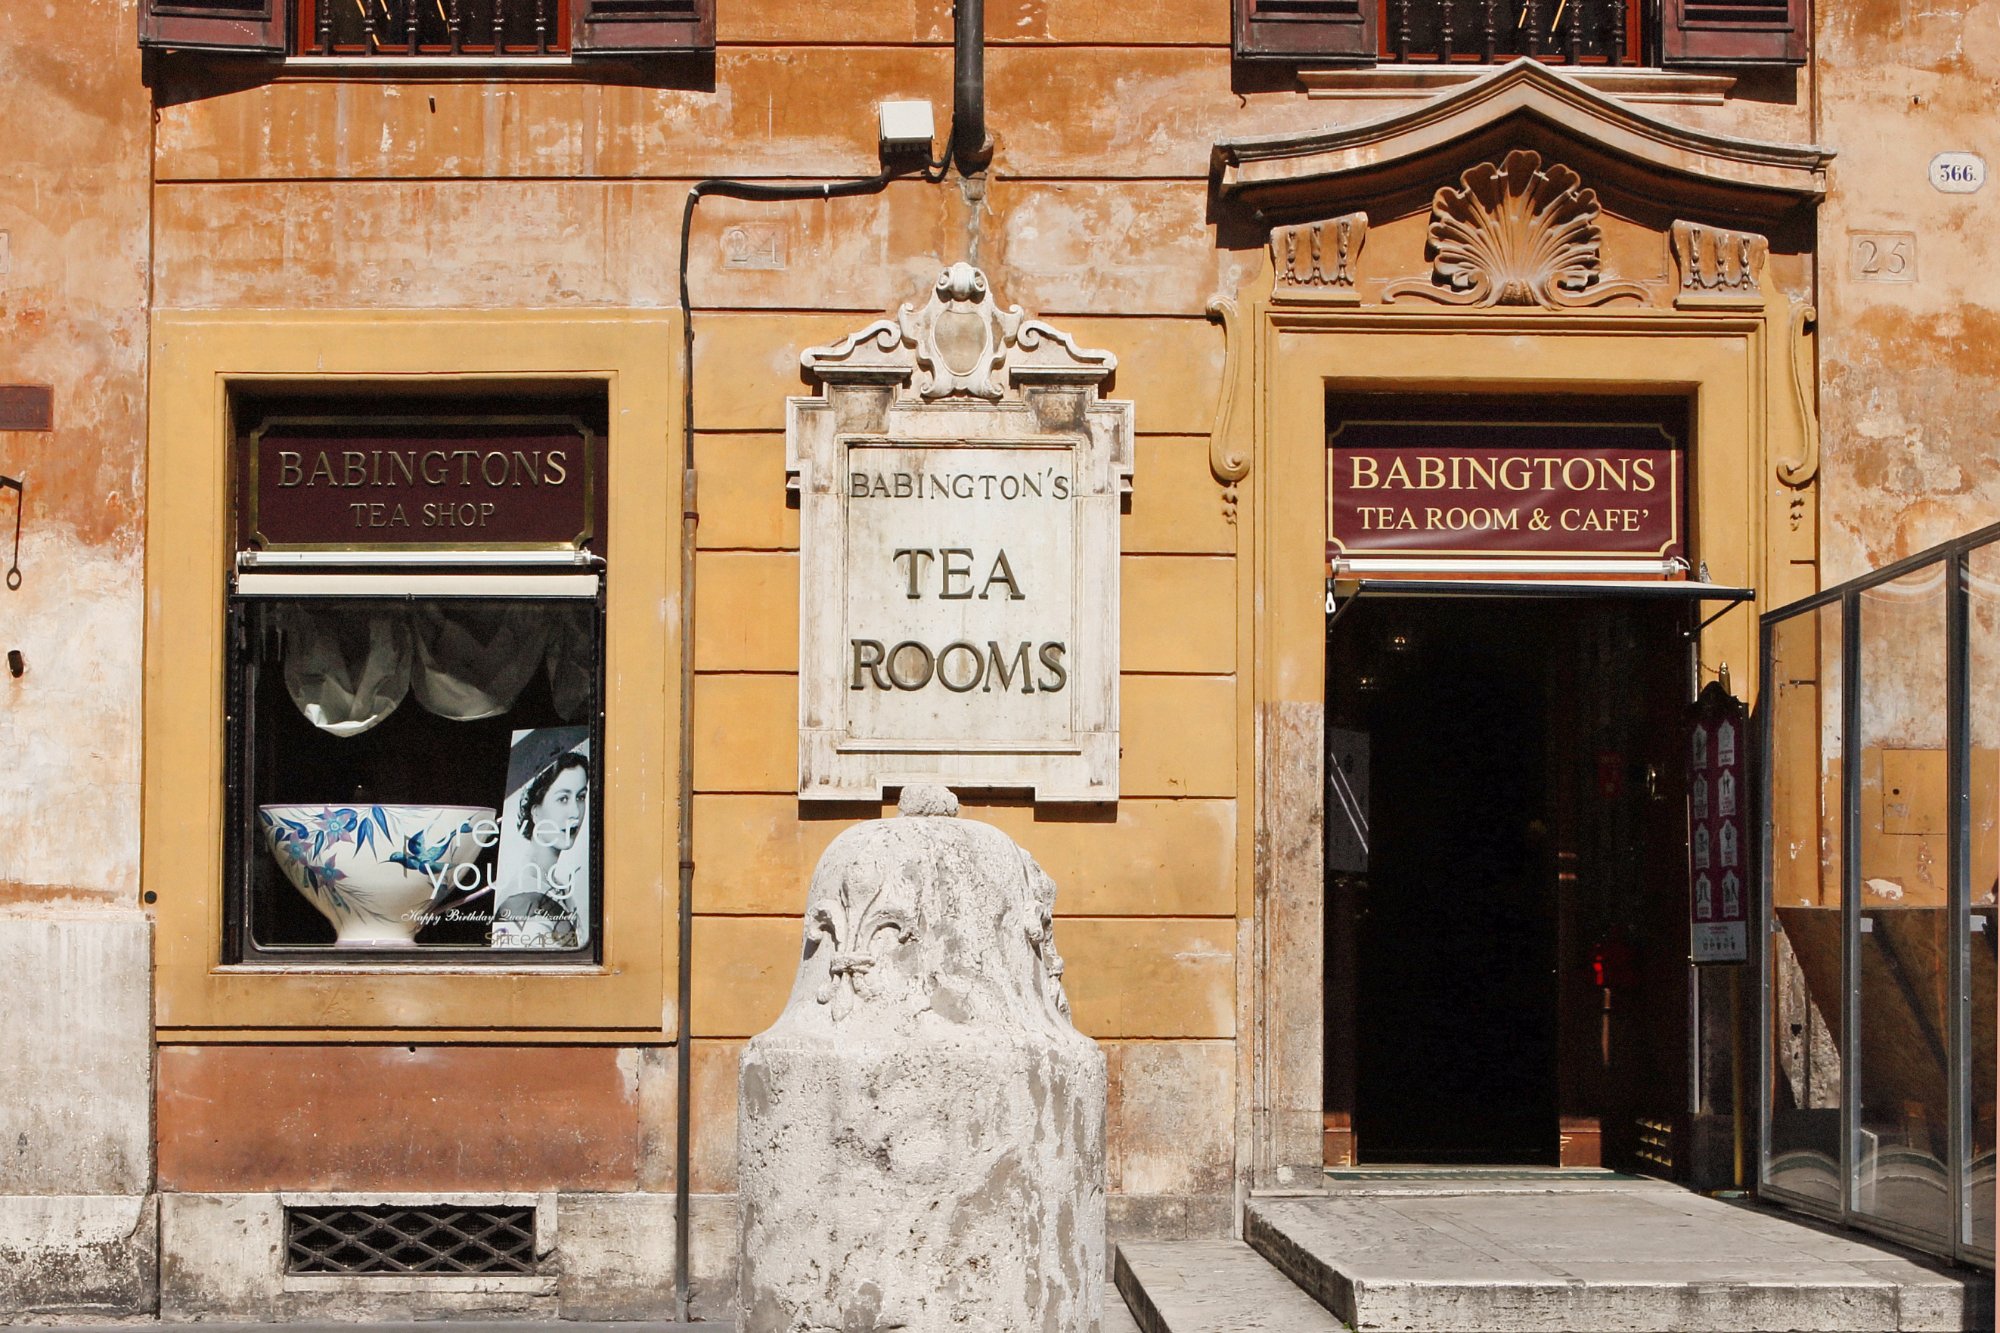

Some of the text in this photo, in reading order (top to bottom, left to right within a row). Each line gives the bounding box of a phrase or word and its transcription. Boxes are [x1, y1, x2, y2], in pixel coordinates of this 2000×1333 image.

[1858, 240, 1906, 273] 25
[278, 451, 567, 487] BABINGTONS
[850, 467, 1070, 500] BABINGTON'S
[1349, 456, 1656, 492] BABINGTONS
[350, 503, 495, 527] TEA SHOP
[1357, 507, 1418, 530] TEA
[1425, 507, 1520, 531] ROOM
[1527, 508, 1552, 531] &
[893, 548, 1026, 600] TEA
[850, 639, 1068, 694] ROOMS
[424, 862, 576, 900] young
[401, 909, 442, 926] Happy
